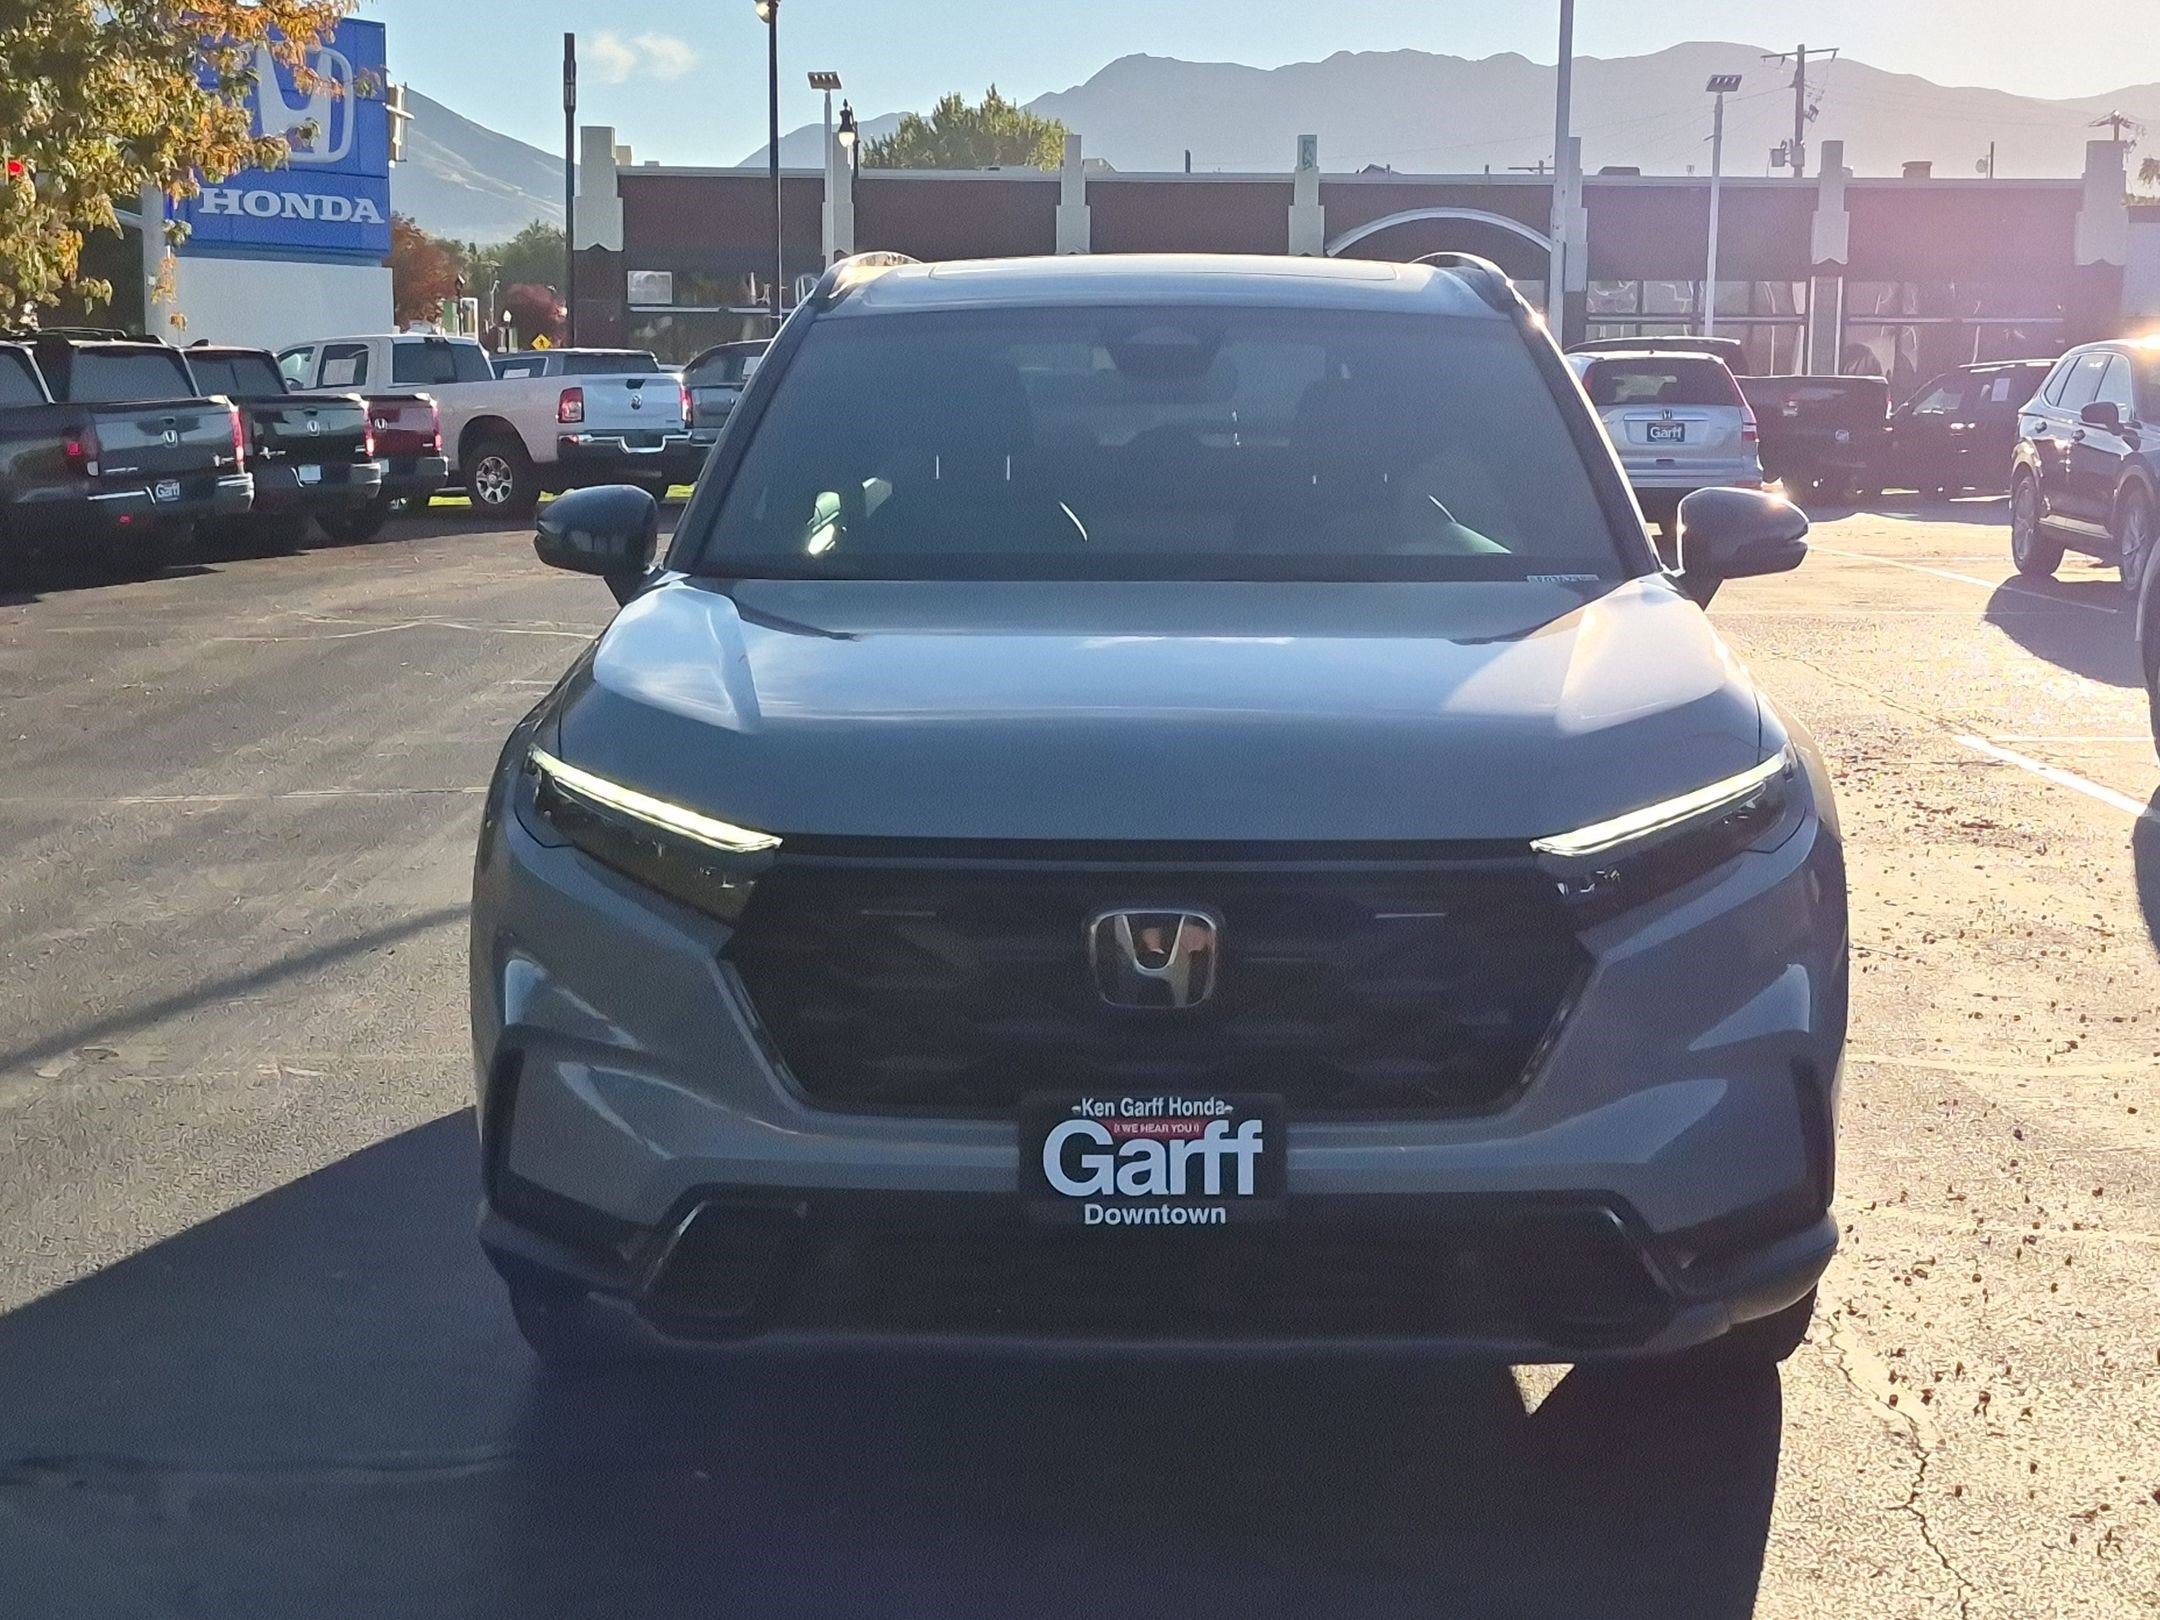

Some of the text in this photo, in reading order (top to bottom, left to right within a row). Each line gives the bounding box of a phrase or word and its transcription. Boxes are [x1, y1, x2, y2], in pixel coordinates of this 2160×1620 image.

[199, 187, 385, 224] HONDA
[1081, 1096, 1225, 1117] Ken Garff Honda
[1122, 1123, 1192, 1133] WE HEAR YOU
[1042, 1119, 1264, 1197] Garff
[1083, 1203, 1226, 1226] Downtown
